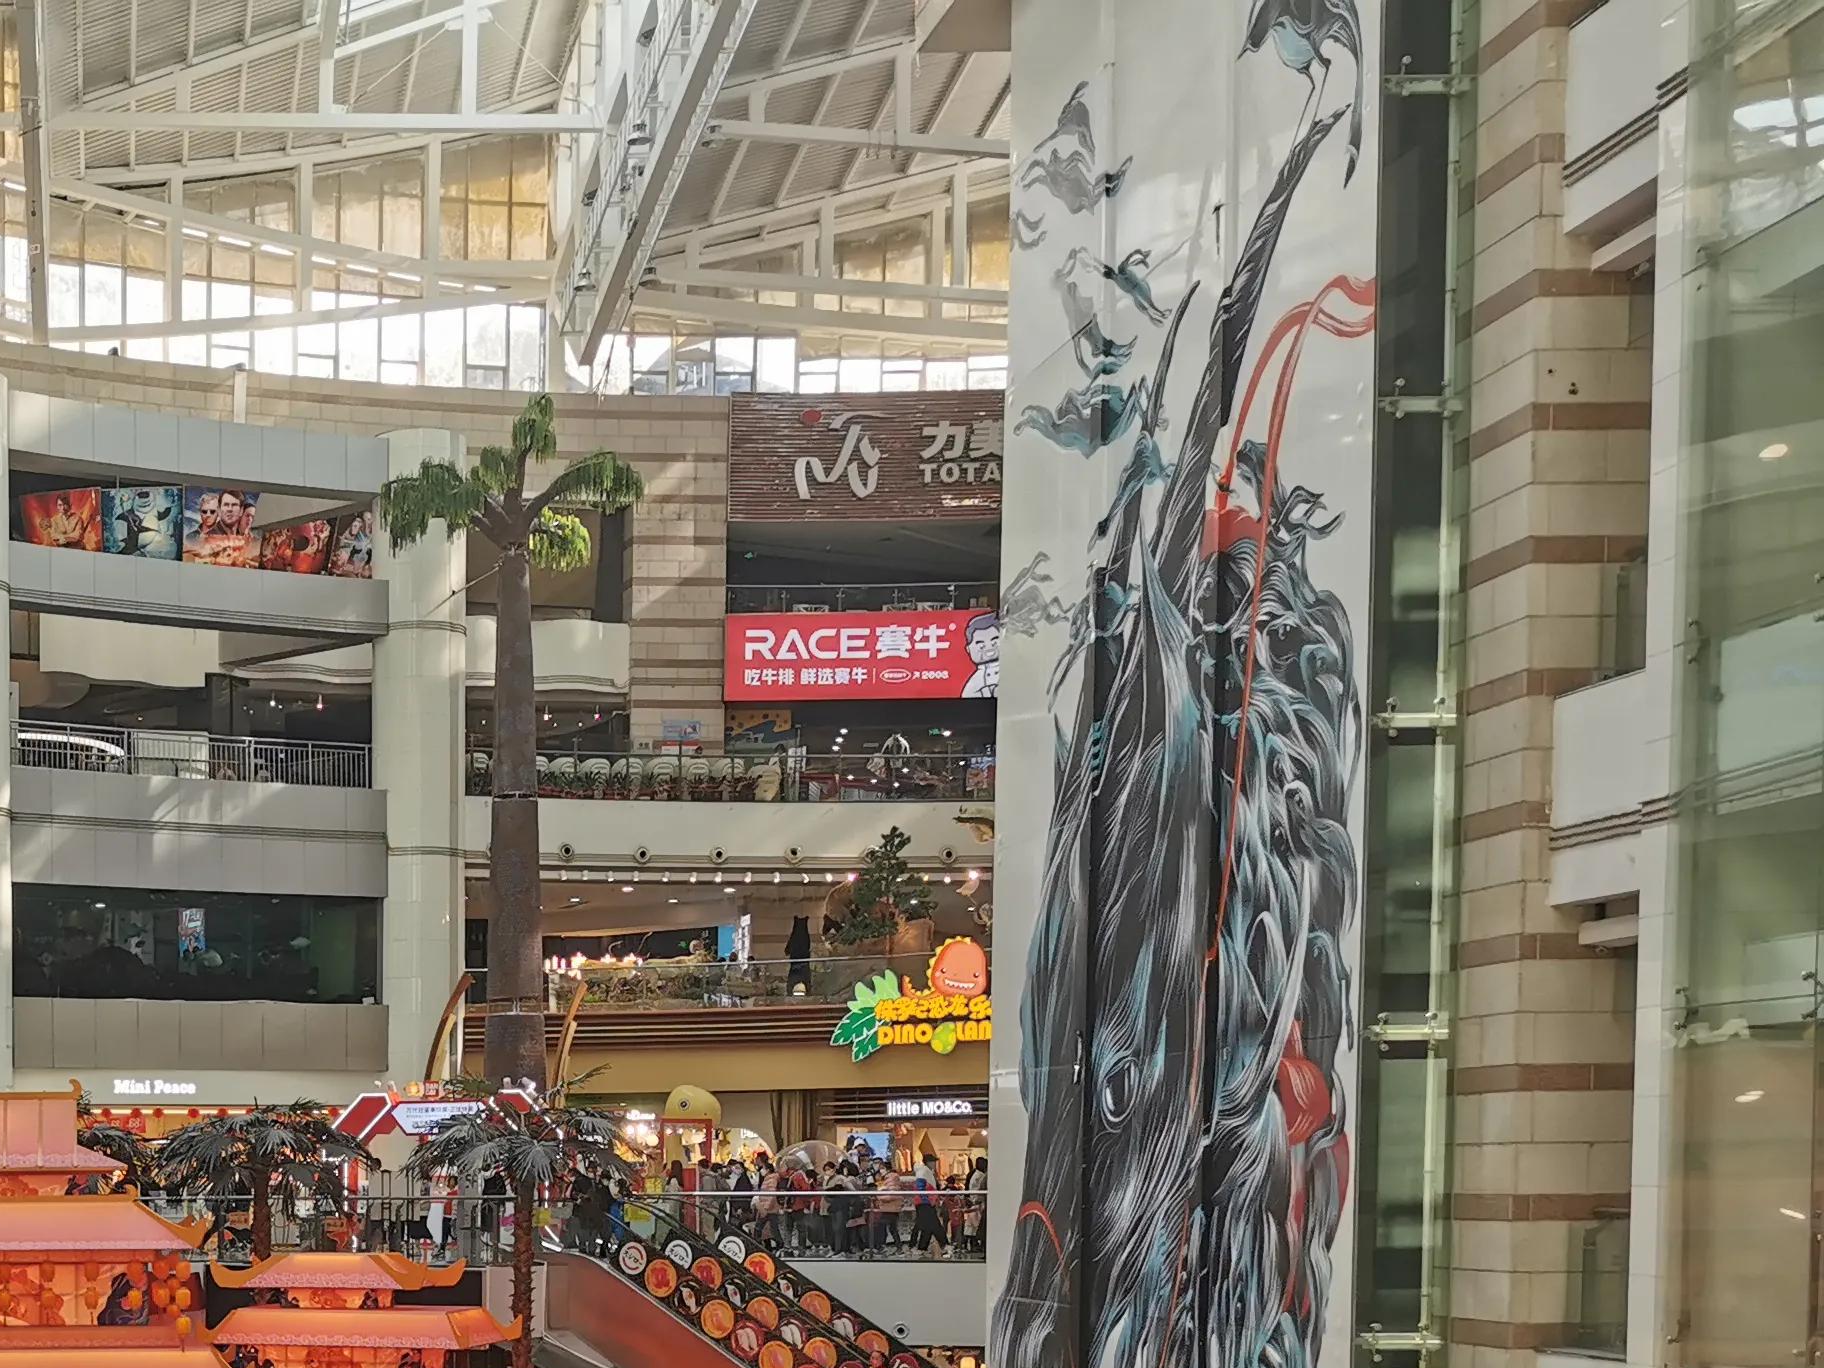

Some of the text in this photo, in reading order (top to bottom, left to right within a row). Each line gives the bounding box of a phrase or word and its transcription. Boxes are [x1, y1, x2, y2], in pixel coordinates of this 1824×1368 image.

[919, 420, 1003, 460] 力美
[744, 628, 872, 660] RACE
[875, 624, 952, 658] 赛牛
[744, 667, 795, 685] 吃牛排
[800, 667, 868, 685] 鲜选赛牛
[877, 1022, 932, 1045] DINO
[113, 1079, 196, 1095] Mini Peace
[888, 1100, 973, 1116] little MO&Co.
